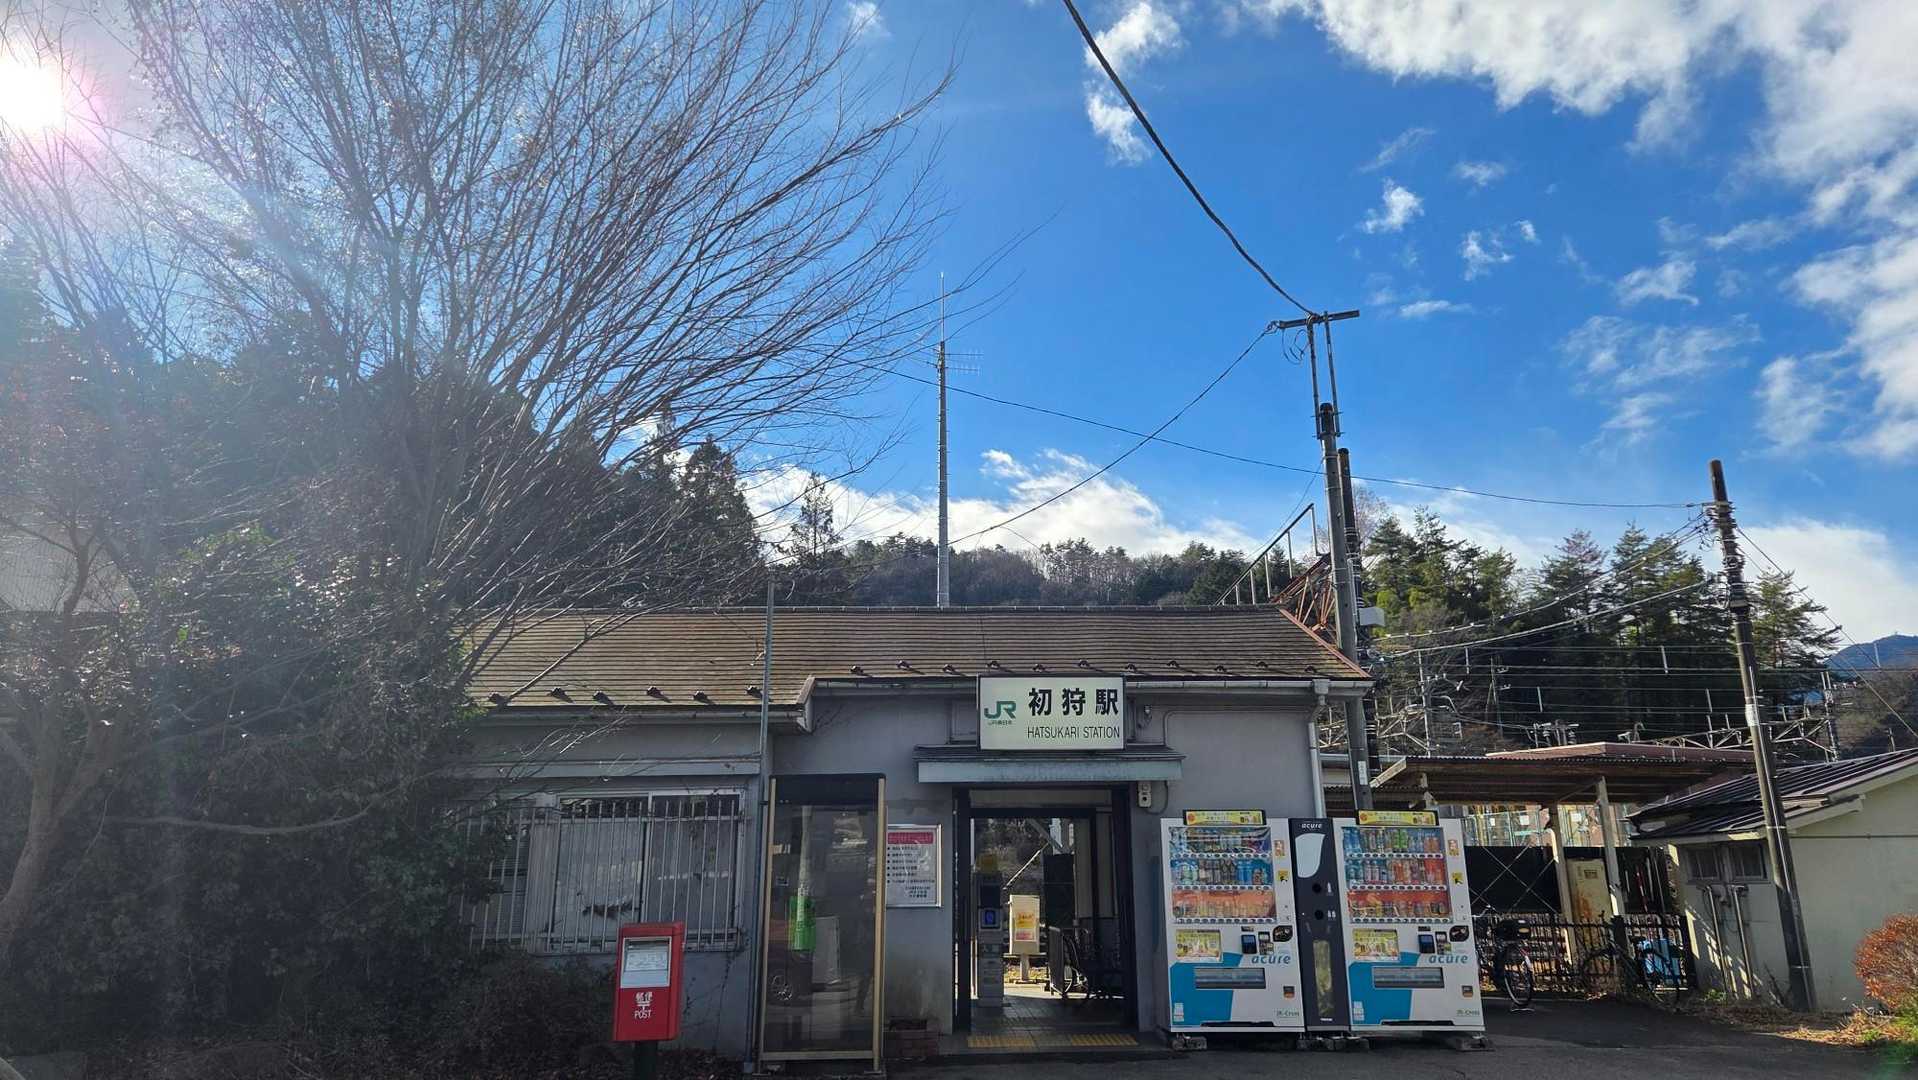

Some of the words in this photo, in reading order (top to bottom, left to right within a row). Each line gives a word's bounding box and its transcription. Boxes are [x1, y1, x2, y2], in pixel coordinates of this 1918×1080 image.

[1028, 687, 1119, 717] 初狩駅
[984, 700, 1017, 719] JR
[1027, 726, 1080, 739] HATSUKARI
[1083, 726, 1120, 739] STATION
[1251, 954, 1292, 965] acure
[1428, 953, 1469, 965] acure
[634, 1009, 652, 1020] POST
